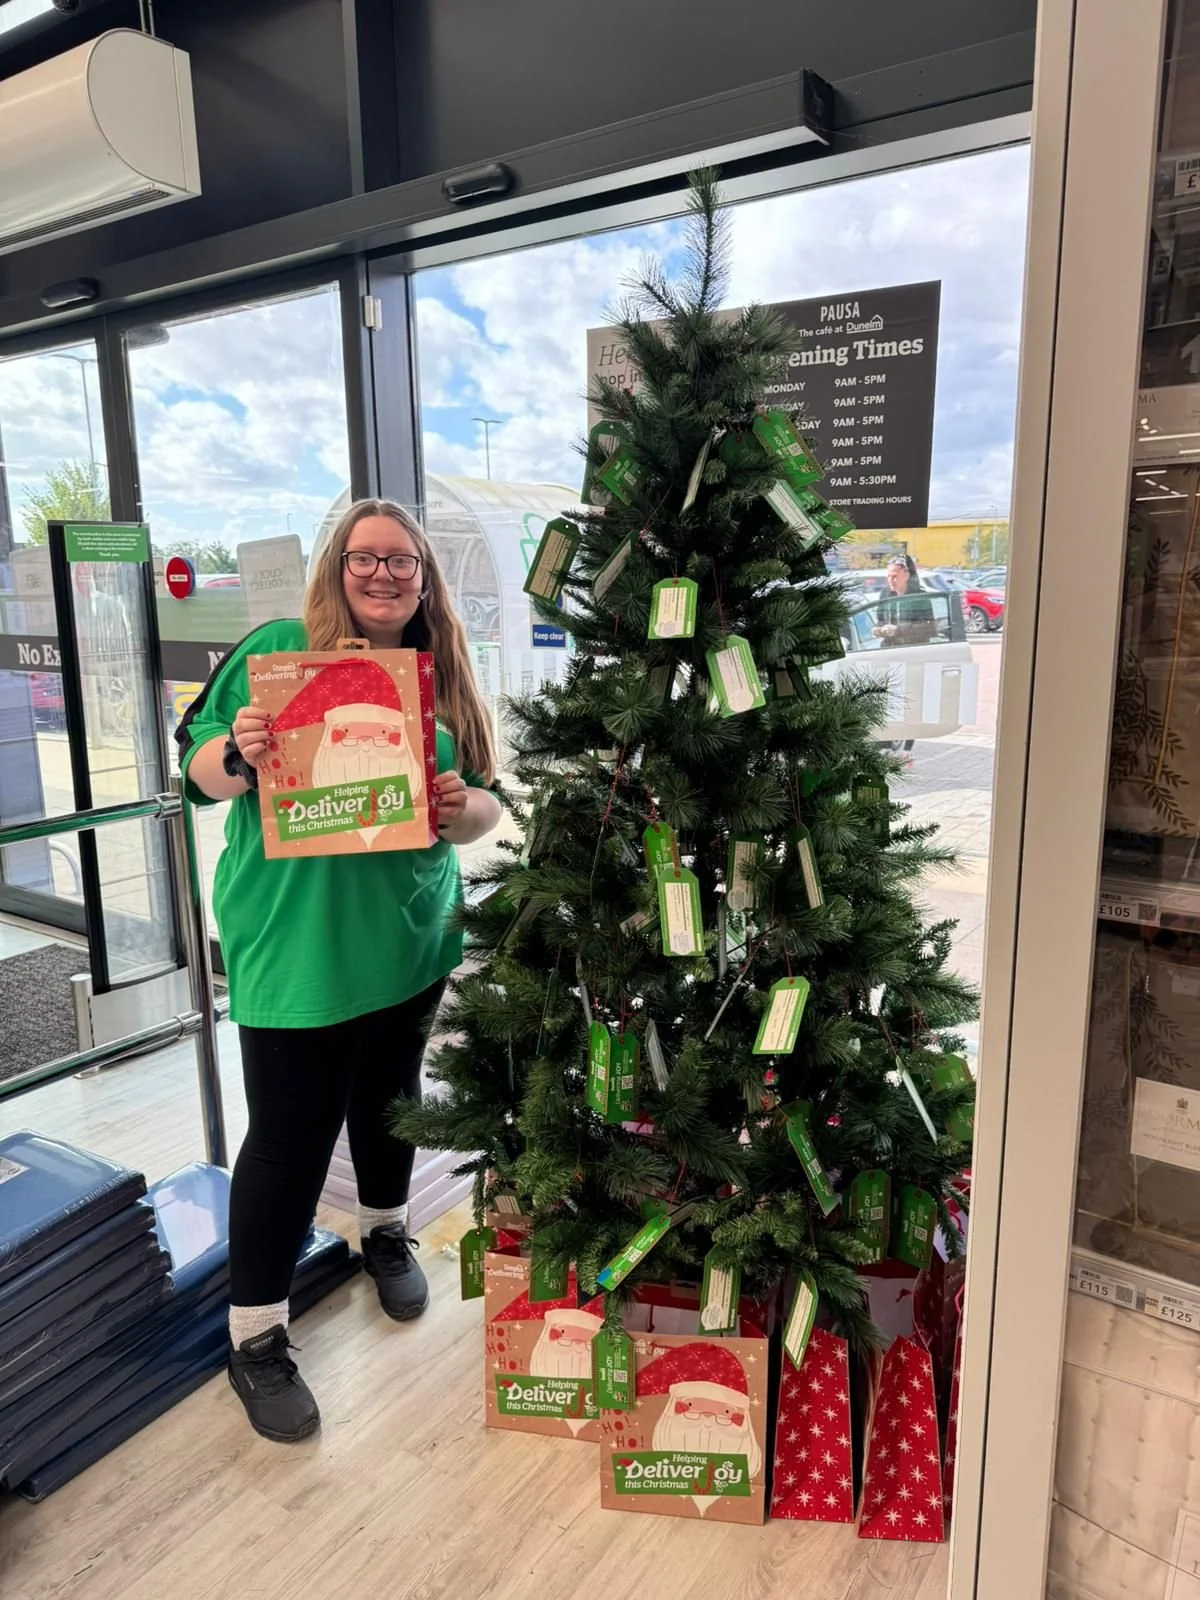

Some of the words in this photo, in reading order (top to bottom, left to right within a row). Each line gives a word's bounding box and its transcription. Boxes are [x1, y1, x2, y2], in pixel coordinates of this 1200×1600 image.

[820, 301, 861, 322] PAUSA
[798, 328, 814, 338] The
[815, 325, 833, 336] café
[834, 325, 844, 334] at
[846, 316, 884, 334] Dunelm
[788, 344, 850, 367] ening
[852, 338, 925, 361] Times
[763, 382, 806, 395] MONDAY
[834, 377, 857, 388] 9AM
[864, 374, 887, 385] 5PM
[833, 397, 856, 408] 9AM
[863, 394, 886, 405] 5PM
[832, 417, 855, 428] 9AM
[862, 415, 885, 426] 5PM
[831, 437, 854, 448] 9AM
[861, 435, 883, 446] 5PM
[831, 457, 853, 467] 9AM
[860, 456, 882, 466] 5PM
[830, 477, 852, 487] 9AM
[859, 474, 897, 486] 5:30PM
[829, 498, 852, 506] STORE
[853, 497, 885, 505] TRADING
[886, 495, 912, 504] HOURS
[534, 631, 549, 641] Keep
[550, 632, 564, 641] clear
[17, 642, 41, 666] No
[254, 671, 297, 682] Delivering
[334, 785, 370, 798] Helping
[288, 795, 367, 823] Deliver
[357, 787, 405, 827] Joy
[288, 823, 306, 833] this
[307, 816, 354, 831] Christmas
[1099, 904, 1130, 918] £105
[1080, 1279, 1109, 1296] £115
[1161, 1306, 1193, 1323] £125
[547, 1380, 579, 1391] Helping
[506, 1382, 576, 1405] Deliver
[506, 1402, 521, 1410] this
[522, 1402, 563, 1413] Christmas
[672, 1454, 708, 1465] Helping
[625, 1458, 705, 1479] Deliver
[693, 1460, 743, 1495] Joy
[625, 1480, 642, 1489] this
[643, 1480, 689, 1489] Christmas
